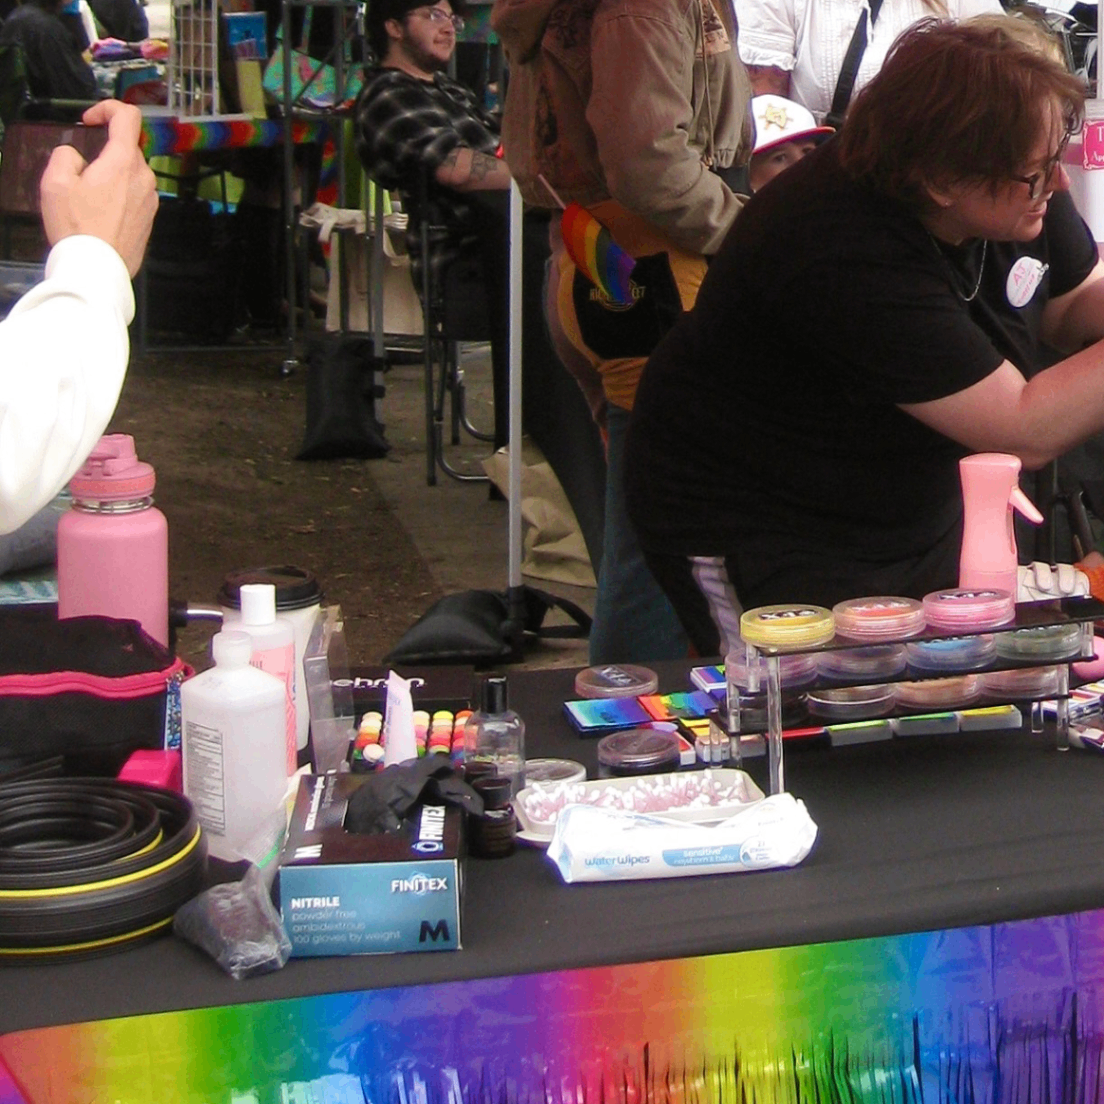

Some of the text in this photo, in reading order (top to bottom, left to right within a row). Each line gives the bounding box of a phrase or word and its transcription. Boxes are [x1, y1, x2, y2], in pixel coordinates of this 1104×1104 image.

[390, 877, 448, 894] FINITEX
[291, 896, 340, 909] NITRILE
[419, 919, 450, 943] M
